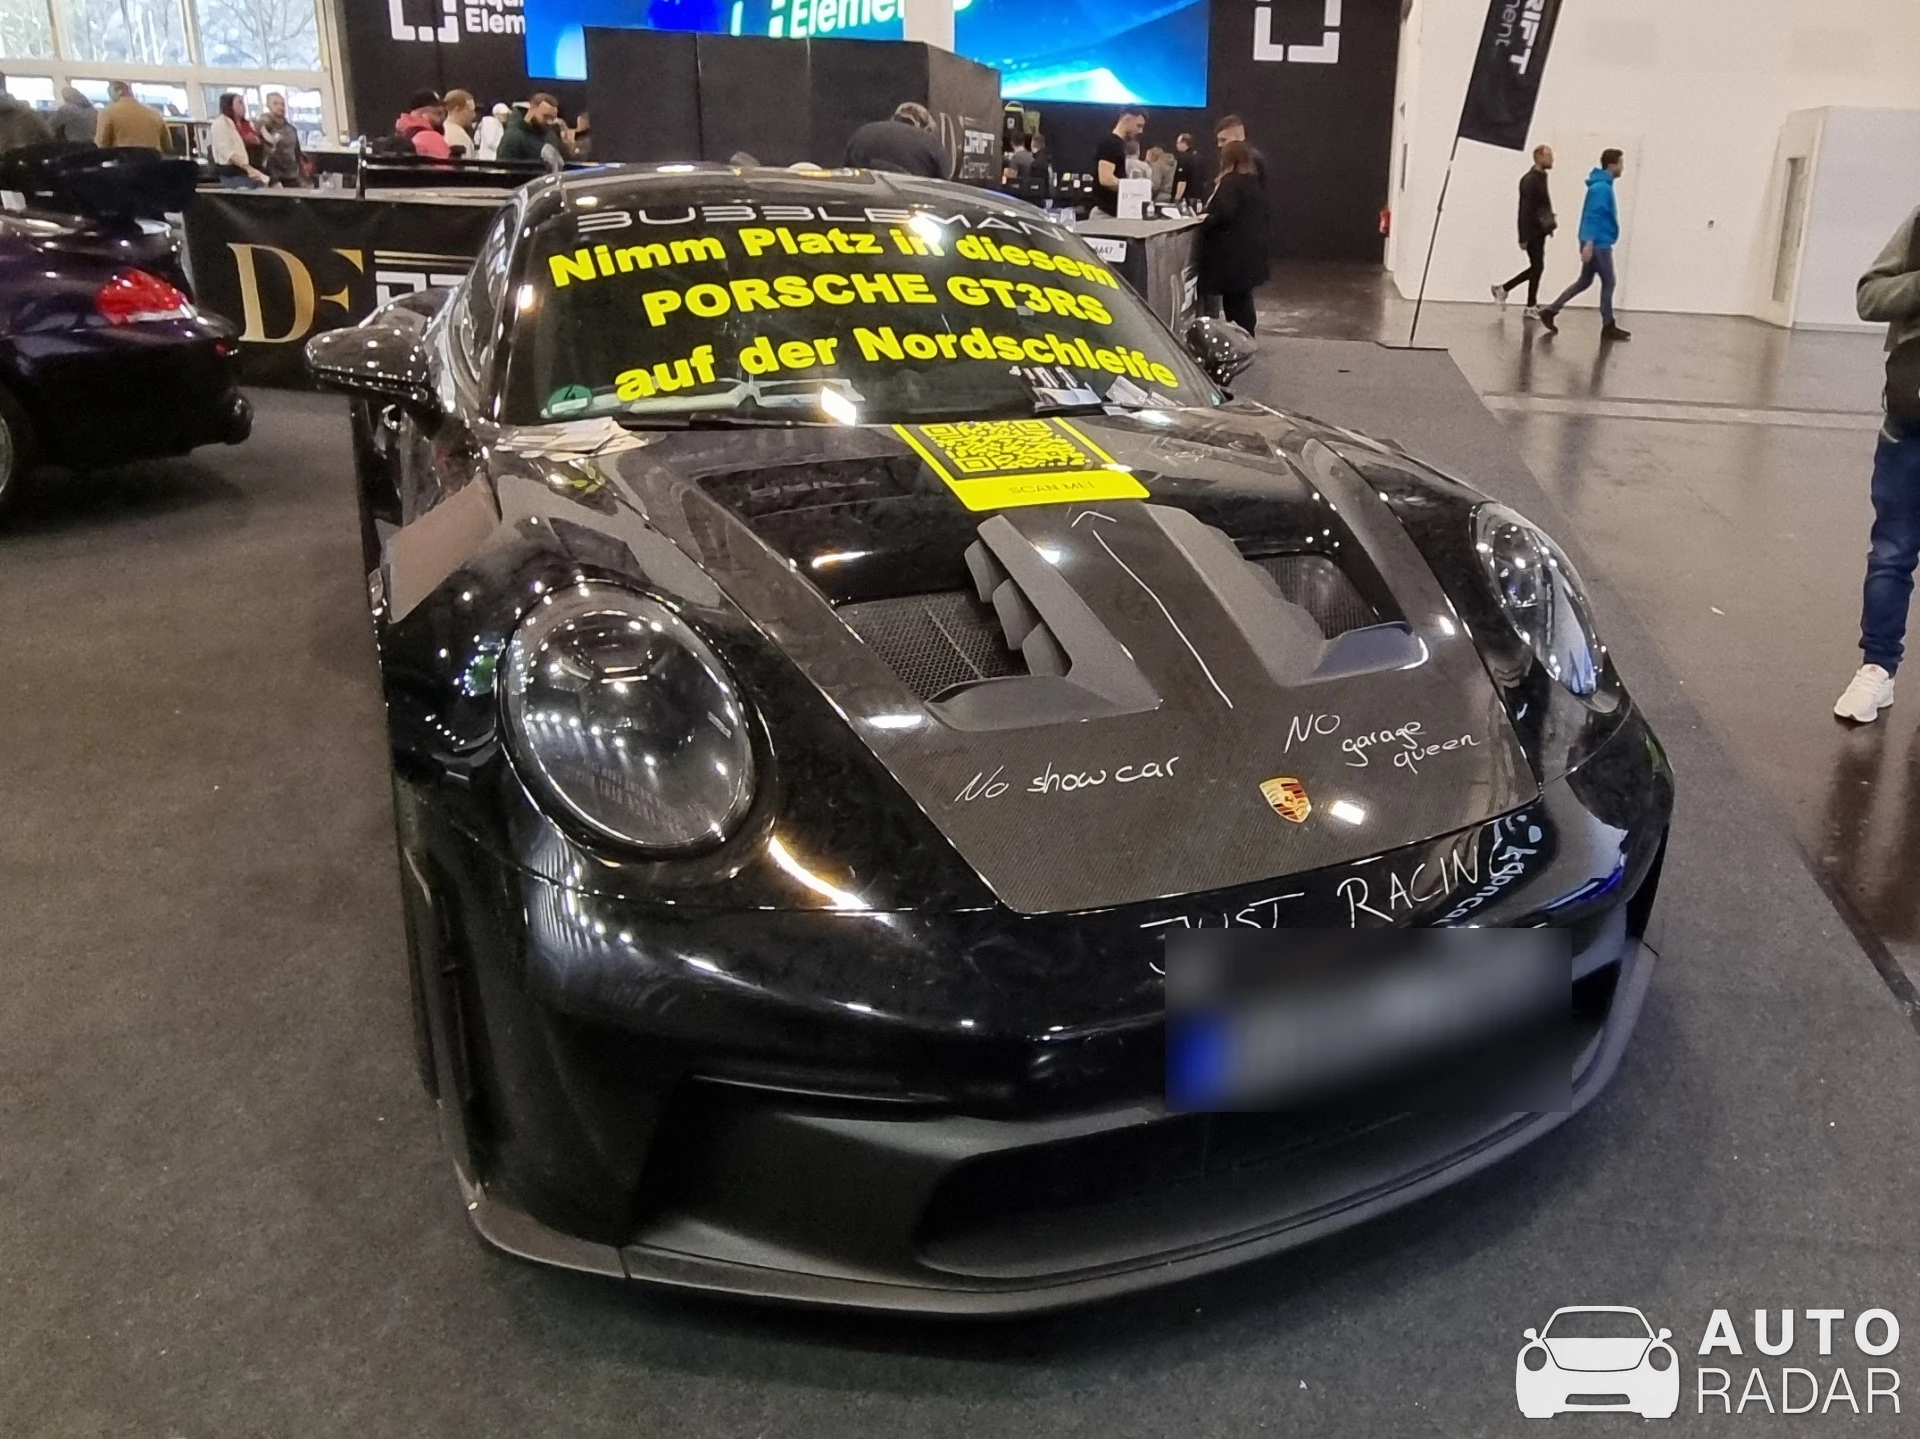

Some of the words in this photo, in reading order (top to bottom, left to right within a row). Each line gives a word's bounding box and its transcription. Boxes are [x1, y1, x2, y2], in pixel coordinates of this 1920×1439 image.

[577, 204, 1064, 242] BUBBLEMAN
[548, 235, 726, 287] Nimm
[738, 227, 884, 257] Platz
[889, 229, 945, 257] in
[955, 234, 1120, 289] diesem
[642, 274, 937, 328] PORSCHE
[946, 276, 1113, 325] GT3RS
[615, 344, 716, 402] auf
[739, 336, 838, 375] der
[853, 327, 1180, 388] Nordschleife
[1008, 483, 1060, 494] SCAN
[1342, 721, 1426, 767] garage
[1393, 734, 1481, 775] queen
[954, 765, 1010, 802] No
[1336, 837, 1524, 929] RACING
